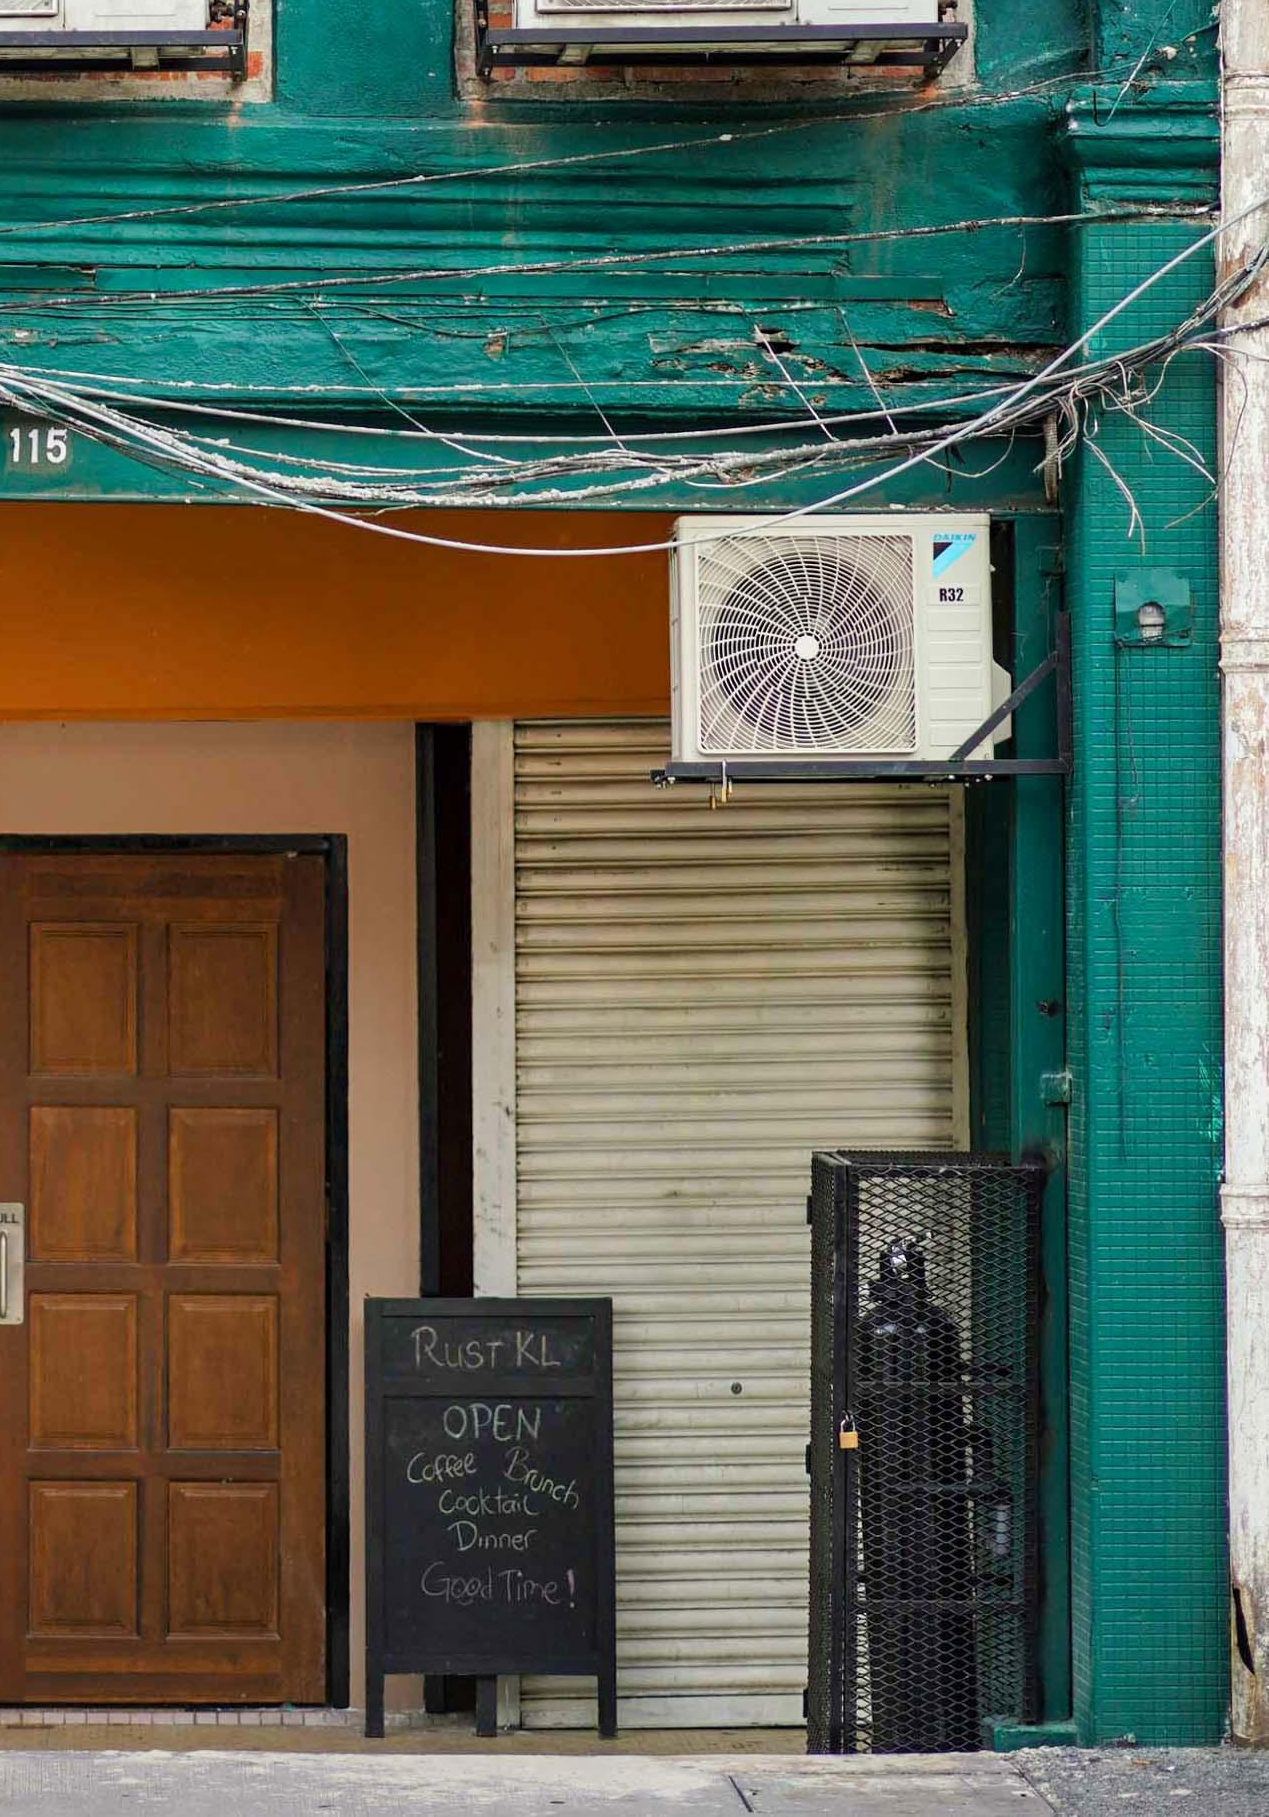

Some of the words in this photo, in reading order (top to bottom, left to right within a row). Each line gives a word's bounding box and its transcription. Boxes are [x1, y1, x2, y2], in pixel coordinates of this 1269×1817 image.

[10, 426, 67, 464] 115
[933, 533, 976, 541] DAIKIN
[939, 588, 964, 602] R32
[516, 1331, 561, 1367] KL
[443, 1402, 541, 1442] OPEN
[407, 1452, 477, 1484] Coffee
[504, 1446, 579, 1510] Brunch
[438, 1486, 539, 1516] Cocktail
[447, 1520, 538, 1551] Dinner
[421, 1561, 493, 1605] Good
